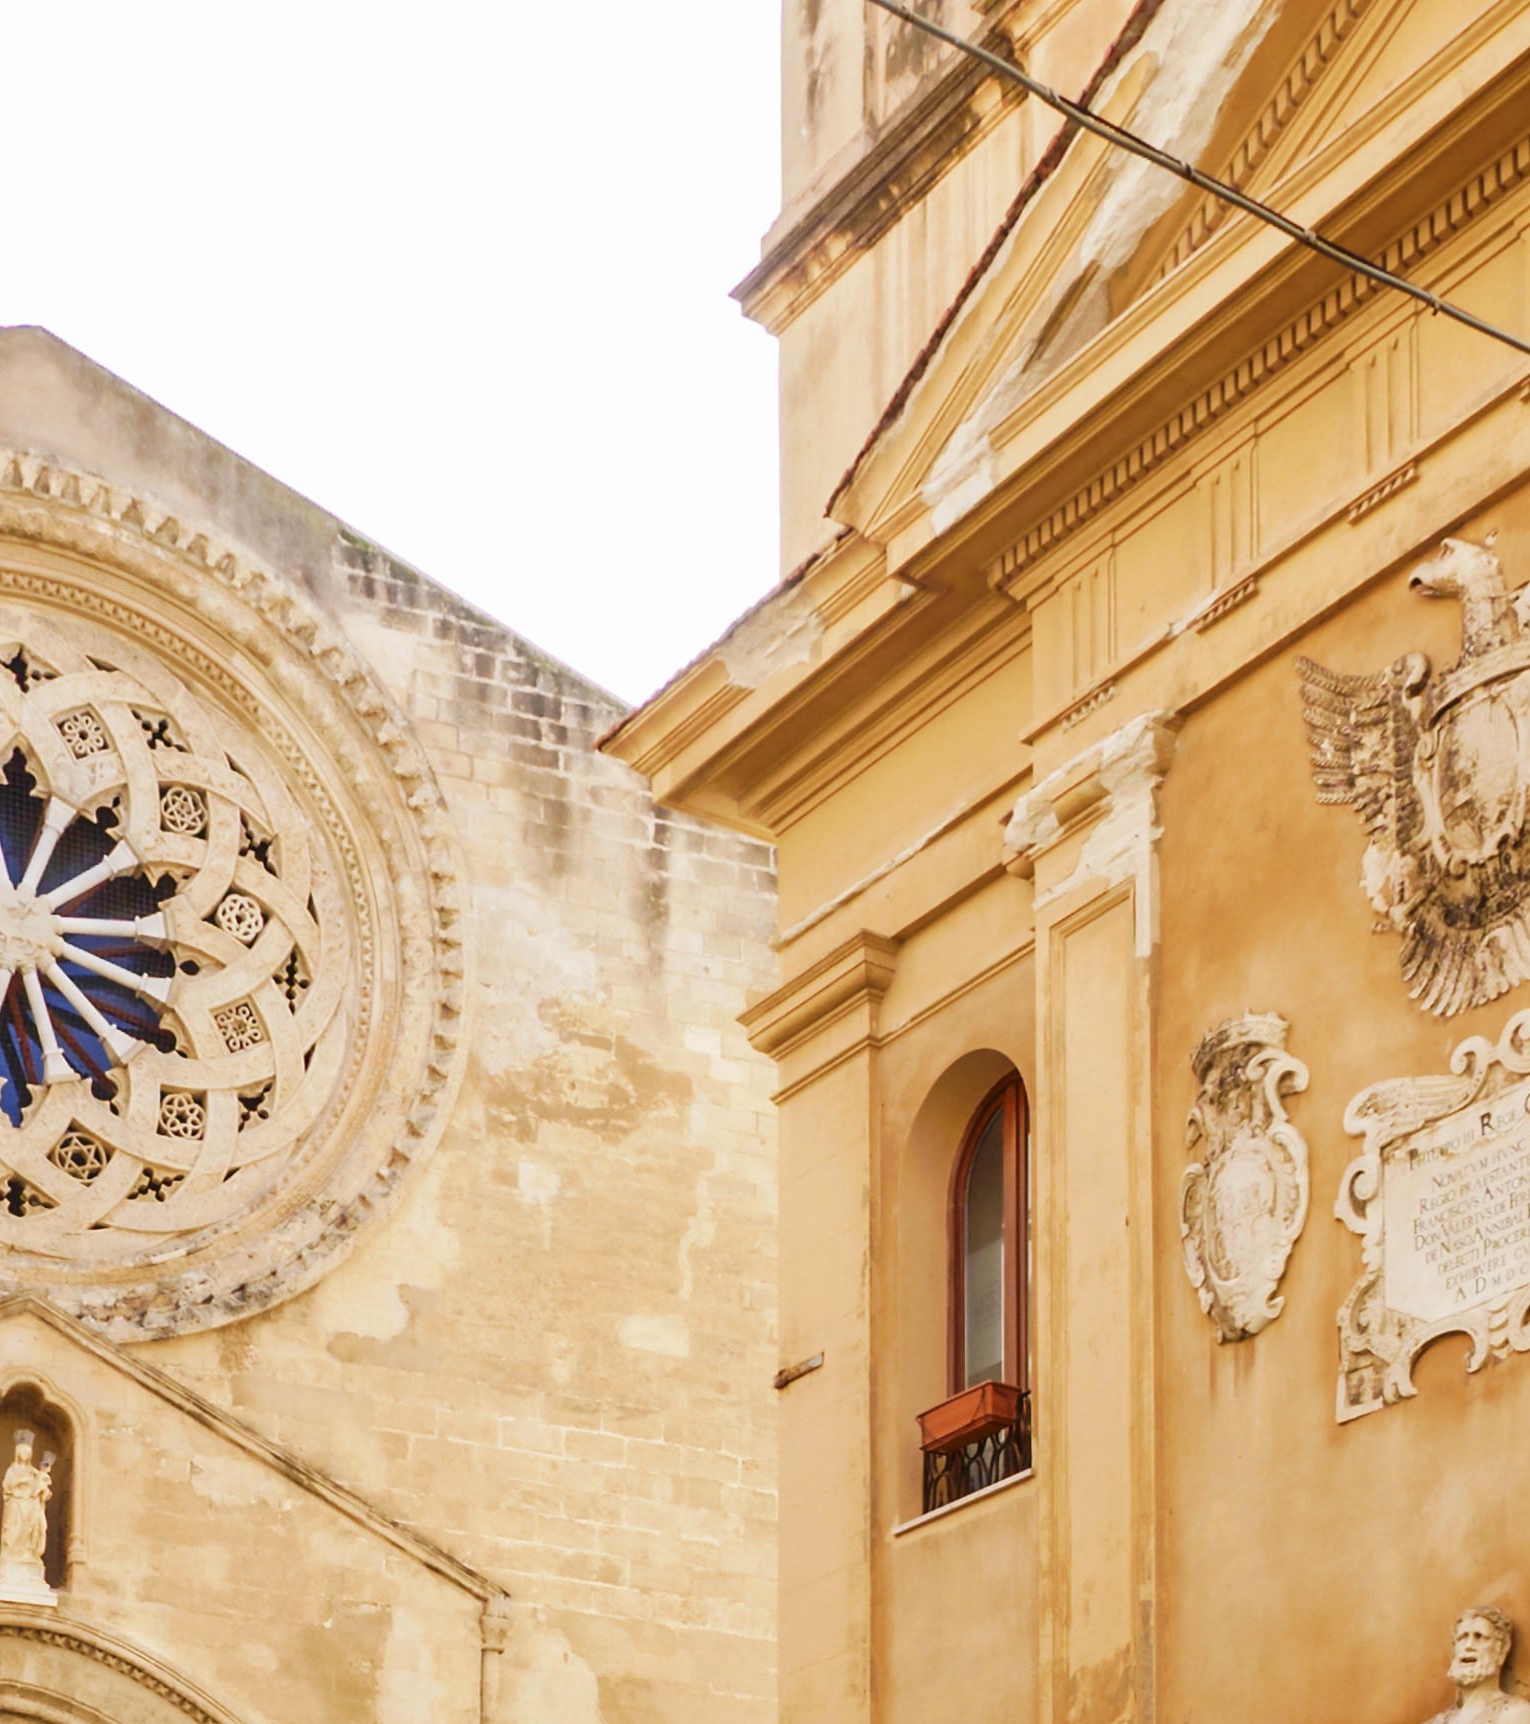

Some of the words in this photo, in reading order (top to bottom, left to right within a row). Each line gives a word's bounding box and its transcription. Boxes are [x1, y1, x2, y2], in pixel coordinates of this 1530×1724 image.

[1492, 1138, 1526, 1163] HVNC
[1413, 1196, 1478, 1233] FRANCISCVS
[1420, 1189, 1455, 1214] REGIO
[1414, 1230, 1439, 1250] DON
[1441, 1207, 1492, 1238] VALERIVS
[1494, 1199, 1506, 1214] DE
[1438, 1248, 1478, 1275] DELECTI
[1446, 1254, 1505, 1289] EXHIBVERE
